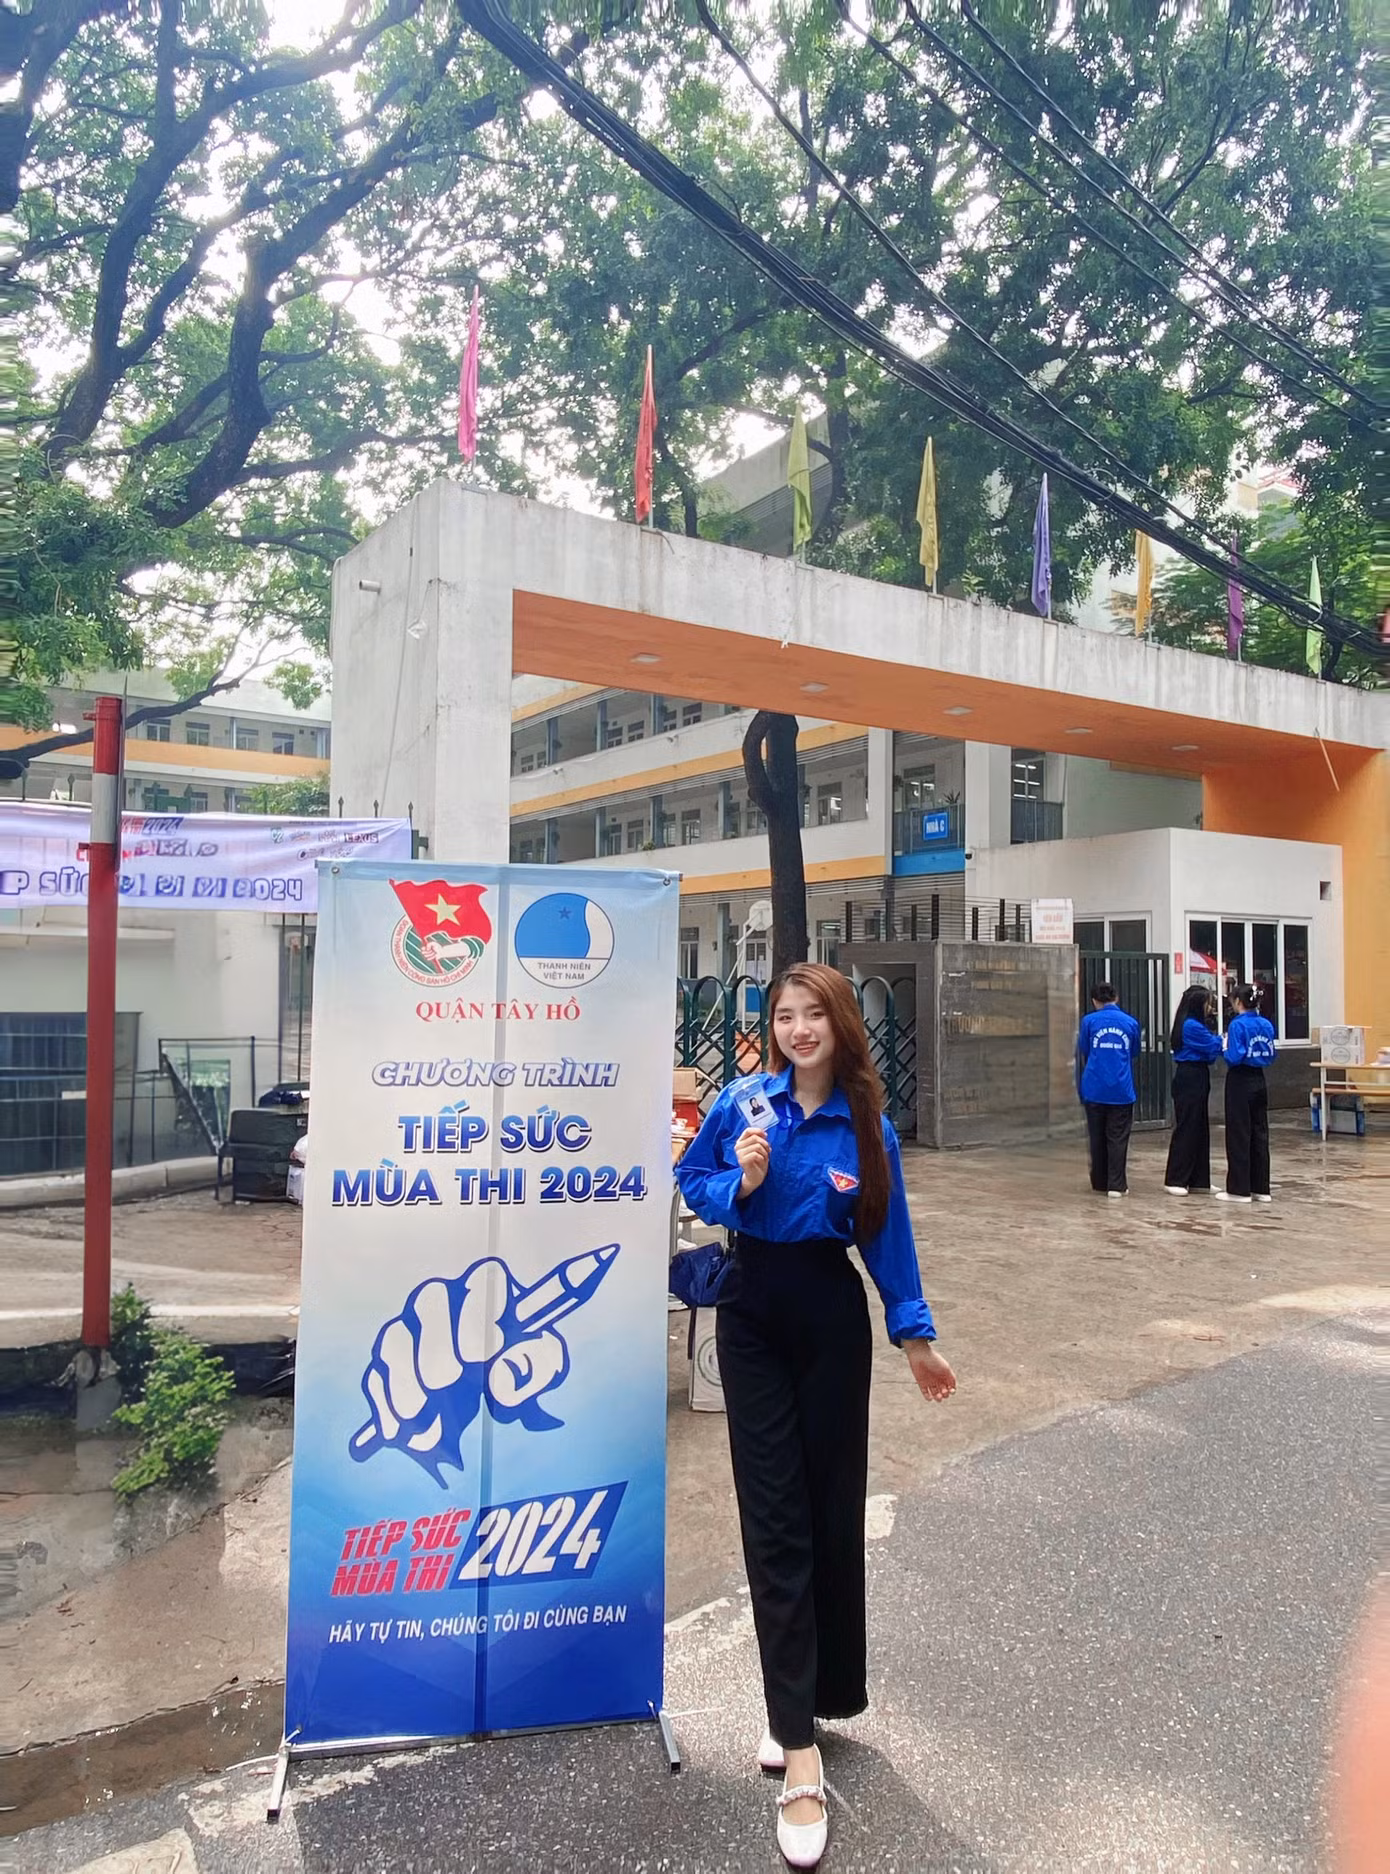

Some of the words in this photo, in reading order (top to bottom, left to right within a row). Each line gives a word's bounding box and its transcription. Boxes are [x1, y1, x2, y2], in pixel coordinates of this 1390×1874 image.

[538, 962, 568, 970] THANH
[570, 962, 591, 970] NIÊN
[565, 972, 584, 980] NAM
[416, 997, 484, 1023] QUẬN
[492, 998, 539, 1020] TÂY
[546, 996, 581, 1020] HỒ
[371, 1058, 517, 1086] CHƯƠNG
[523, 1057, 620, 1087] TRÌNH
[398, 1100, 489, 1153] TIẾP
[499, 1104, 592, 1153] SỨC
[331, 1158, 442, 1206] MÙA
[454, 1166, 527, 1205] THI
[539, 1165, 648, 1201] 2024
[340, 1517, 408, 1562] TIẾP
[410, 1506, 472, 1552] SỨC
[458, 1489, 609, 1580] 2024
[330, 1558, 399, 1597] MÙA
[402, 1552, 456, 1594] THI
[328, 1619, 366, 1644] HÃY
[369, 1618, 394, 1644] TỰ
[396, 1619, 425, 1641] TIN,
[430, 1612, 488, 1637] CHÚNG
[493, 1608, 520, 1633] TÔI
[523, 1610, 540, 1630] ĐI
[543, 1604, 589, 1628] CÙNG
[592, 1604, 627, 1627] BẠN
